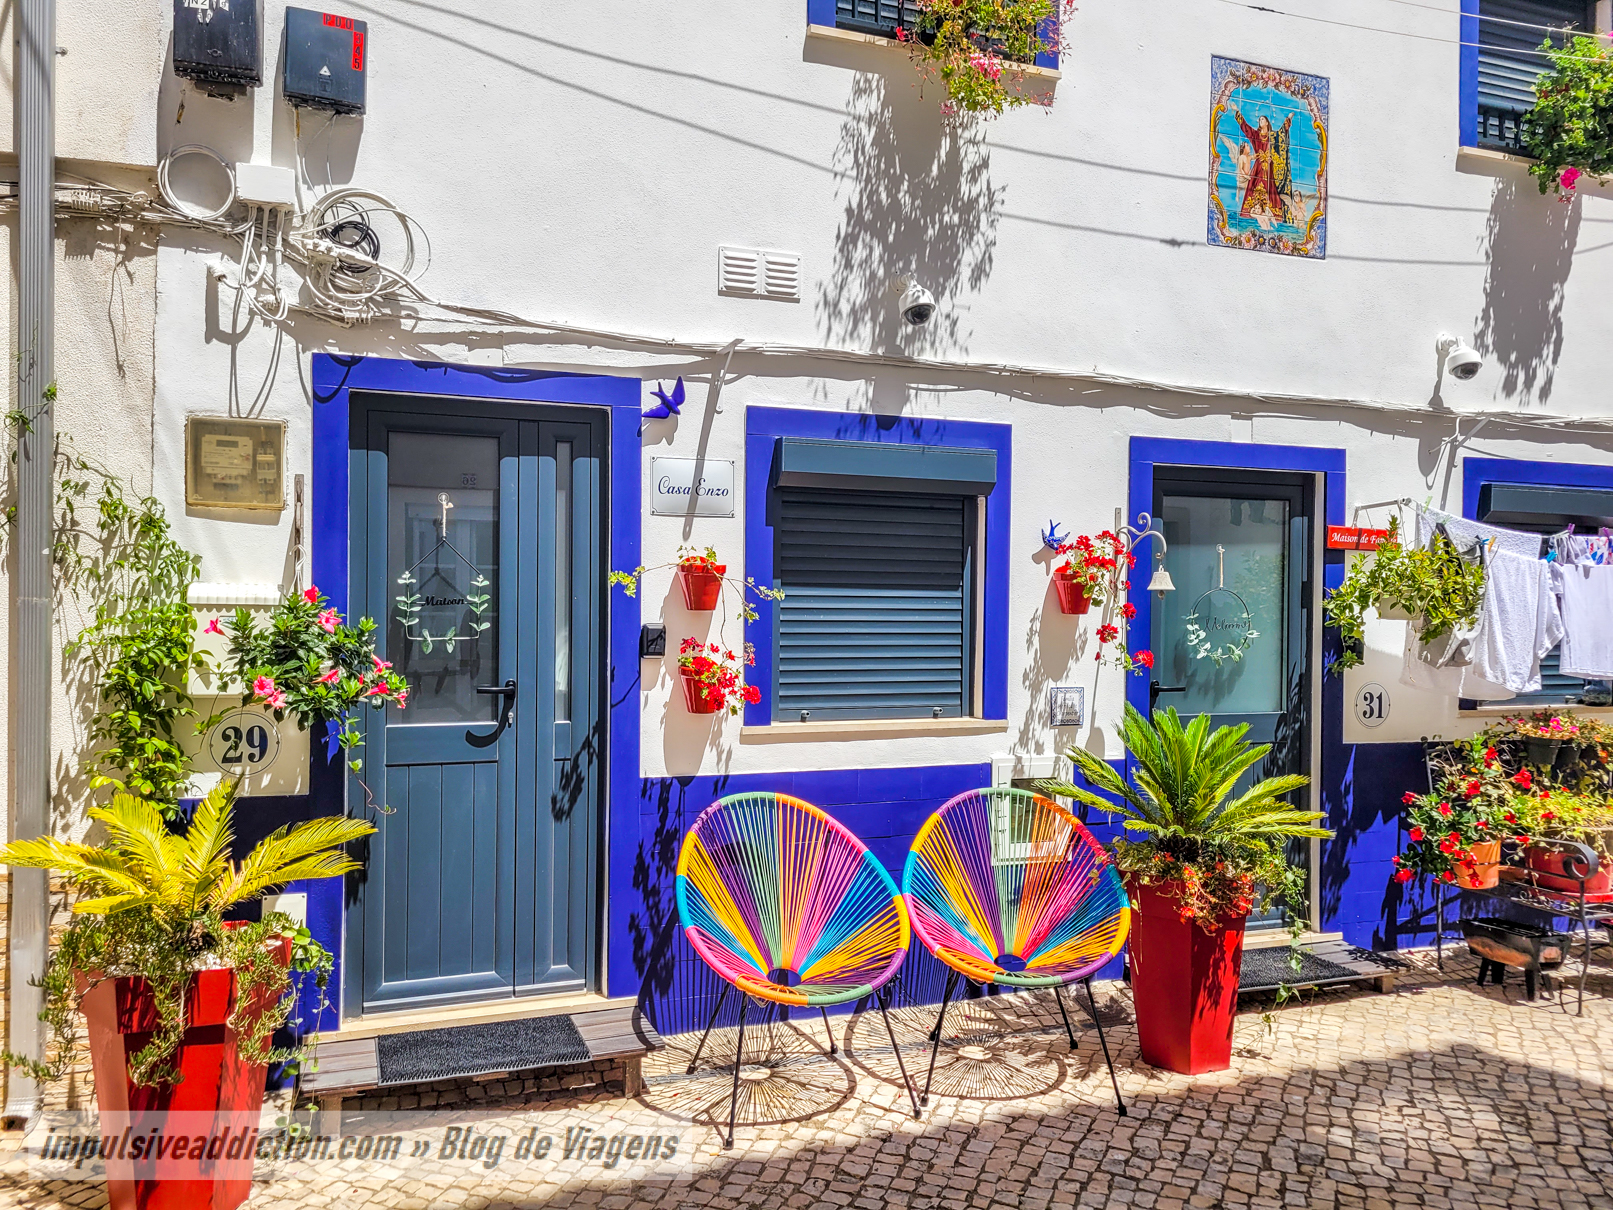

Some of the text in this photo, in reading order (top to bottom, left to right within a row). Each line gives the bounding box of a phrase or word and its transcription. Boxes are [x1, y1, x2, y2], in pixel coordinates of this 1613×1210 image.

[354, 33, 362, 69] 345
[657, 475, 729, 497] Casa Enzo
[1331, 532, 1359, 543] Maison
[1359, 533, 1369, 544] de
[1362, 691, 1384, 719] 31
[221, 725, 268, 764] 29
